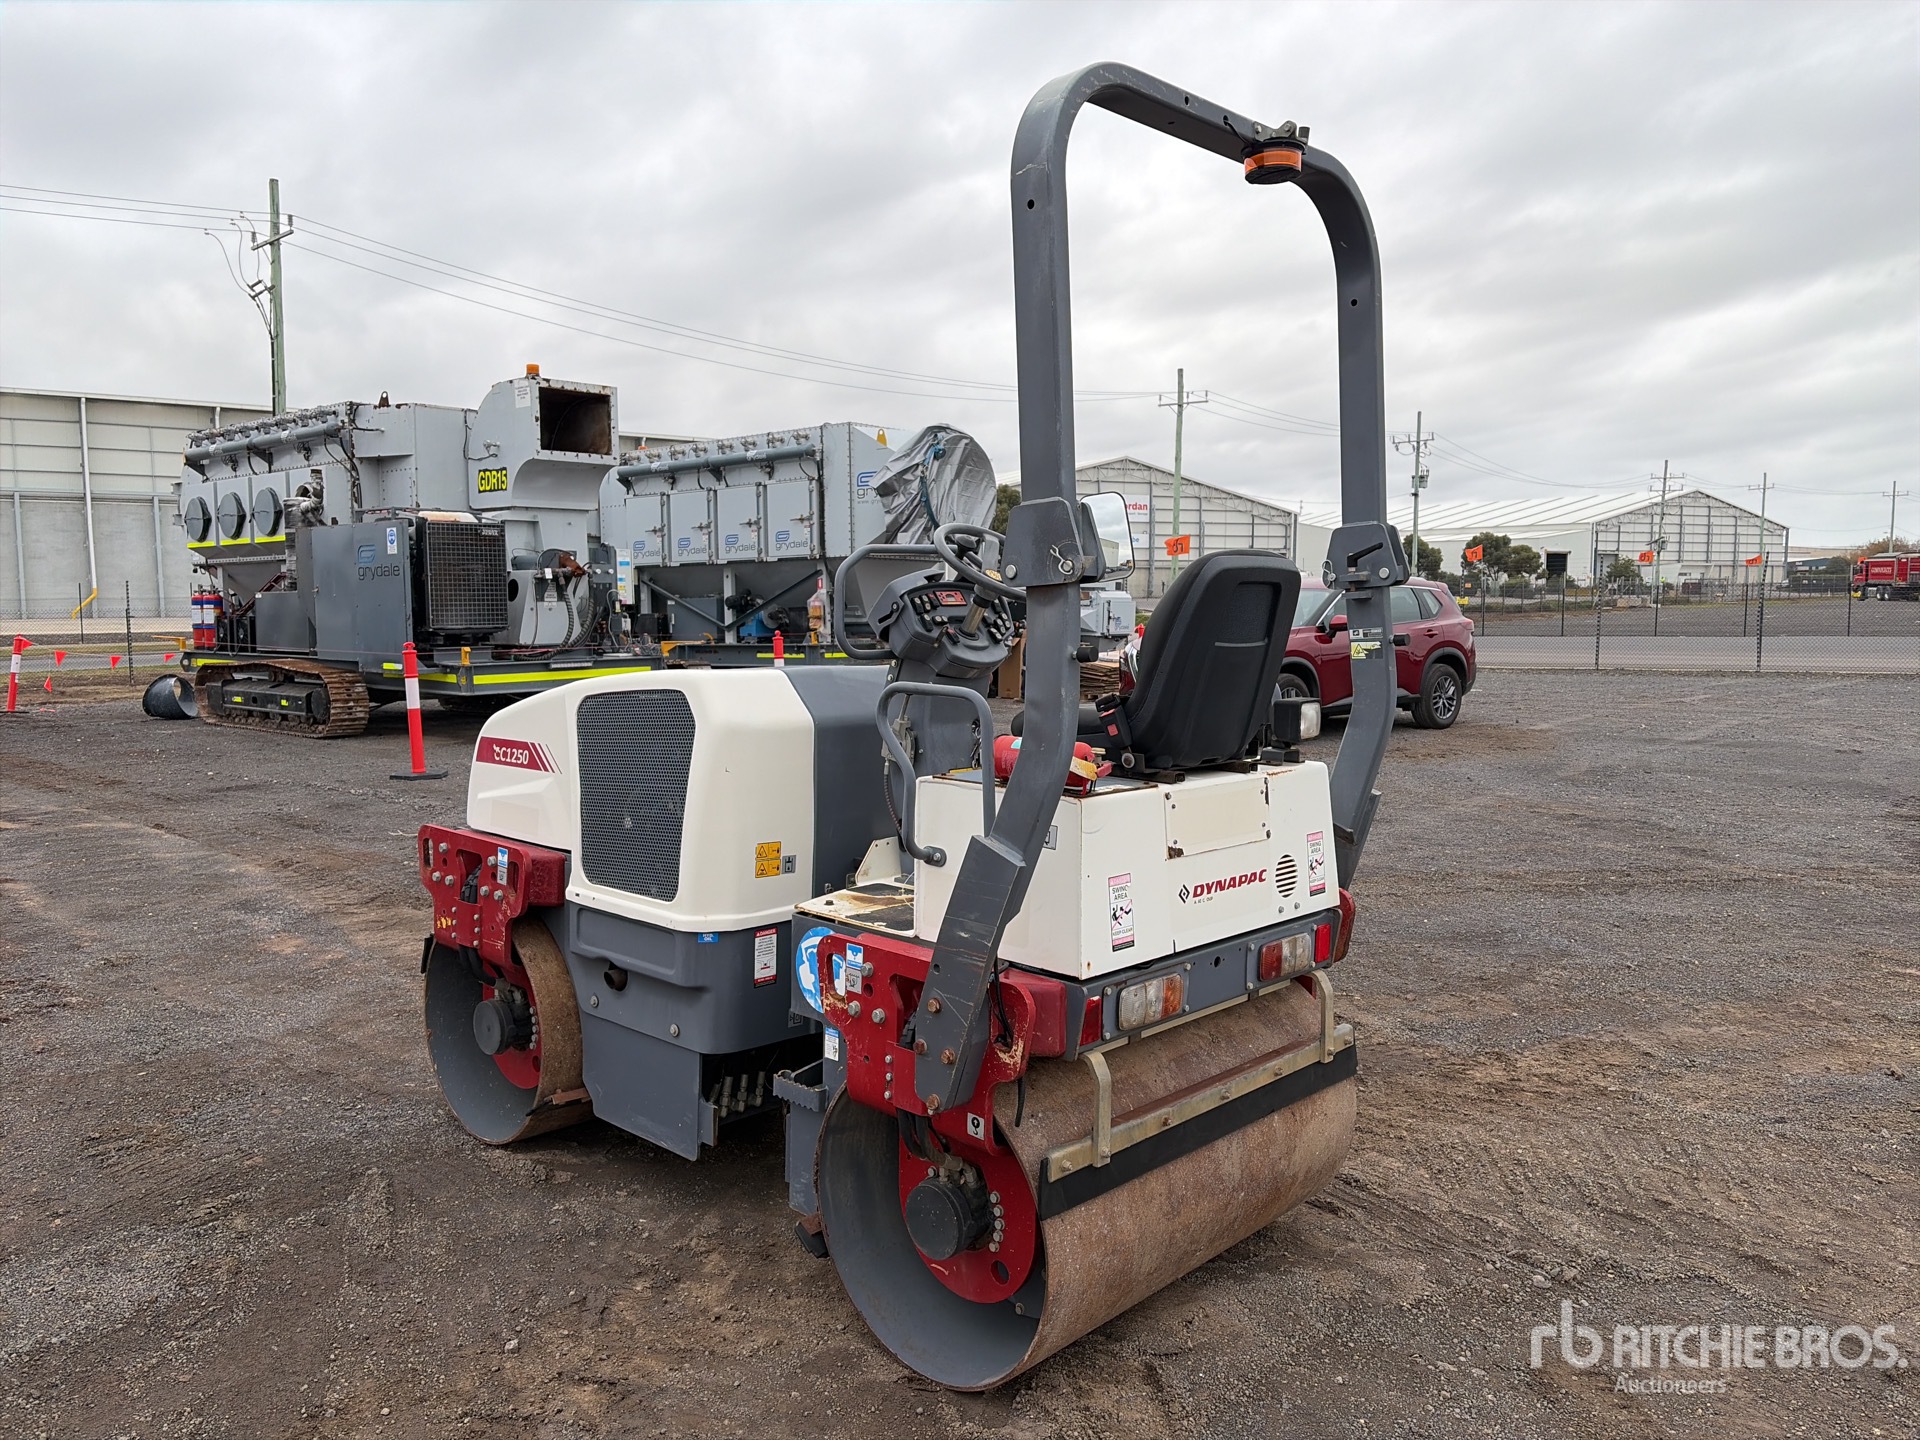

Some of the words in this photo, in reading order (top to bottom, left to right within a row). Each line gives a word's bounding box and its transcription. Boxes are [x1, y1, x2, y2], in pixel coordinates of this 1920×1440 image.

[478, 470, 507, 491] GDR15
[678, 545, 708, 556] grydale
[725, 542, 756, 554] grydale
[776, 538, 809, 551] grydale
[633, 548, 661, 559] grydale
[358, 563, 401, 580] grydale
[493, 745, 530, 765] CC1250
[1193, 869, 1267, 898] DYNAPAC
[1114, 892, 1128, 901] AREA
[1122, 927, 1133, 935] CLEAR
